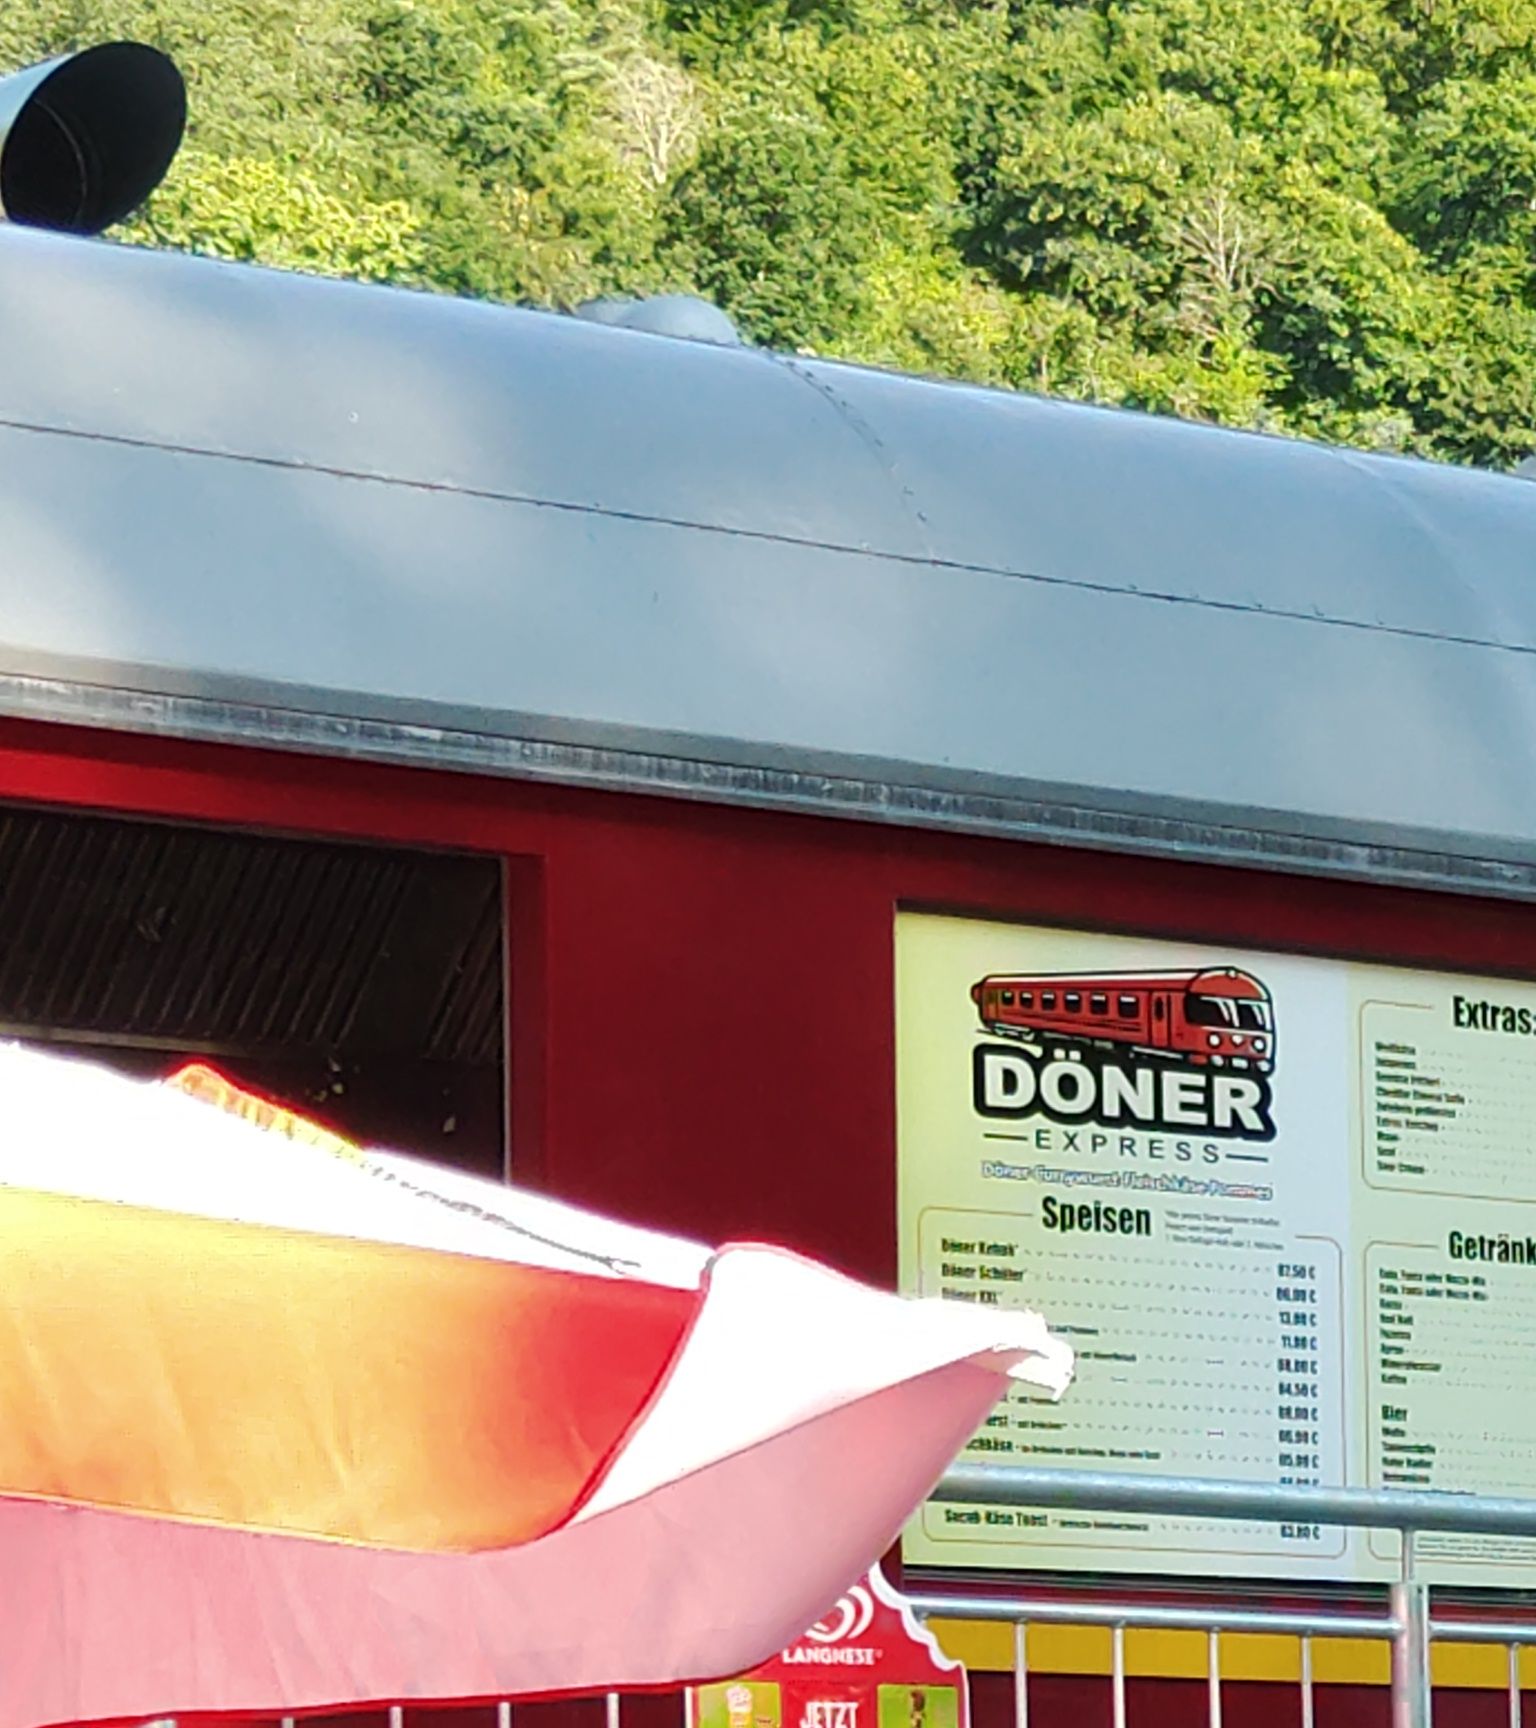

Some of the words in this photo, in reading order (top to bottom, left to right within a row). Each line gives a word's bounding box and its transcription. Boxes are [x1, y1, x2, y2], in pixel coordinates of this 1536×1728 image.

[984, 1048, 1266, 1132] DÖNER
[1035, 1128, 1220, 1164] EXPRESS
[1042, 1195, 1151, 1237] Speisen
[1381, 1405, 1408, 1422] Bier
[782, 1647, 876, 1665] LANGNESE
